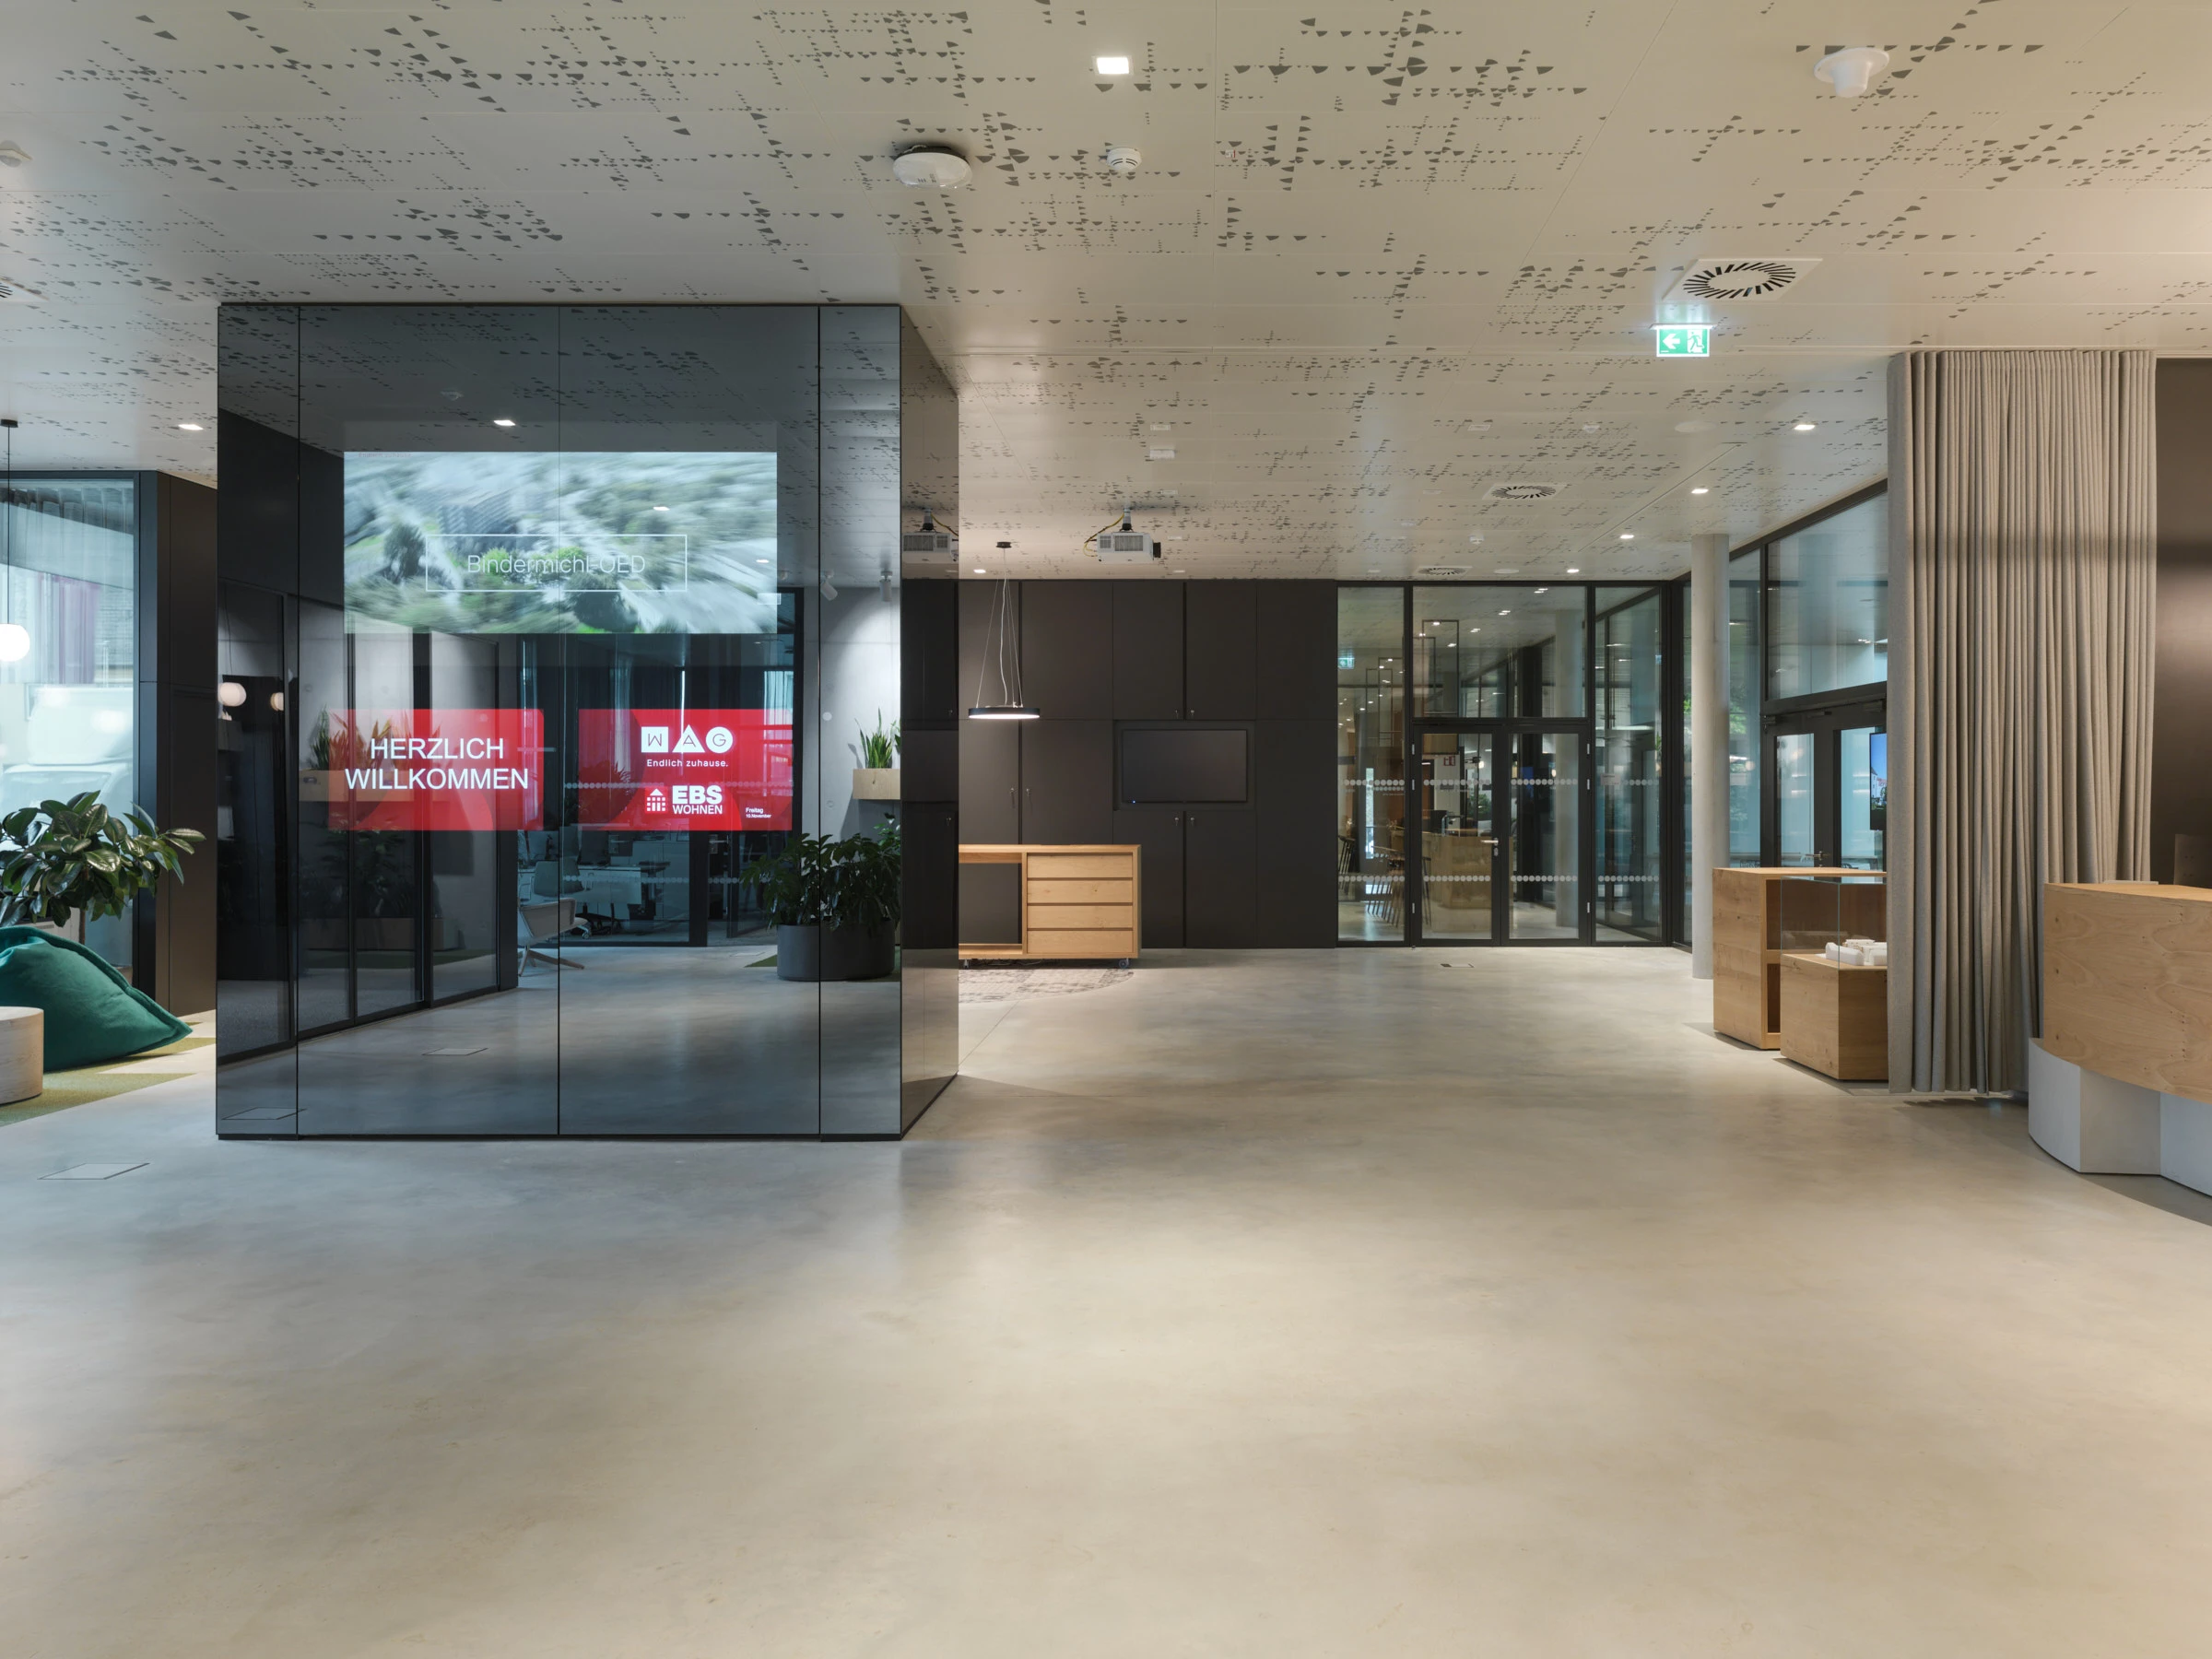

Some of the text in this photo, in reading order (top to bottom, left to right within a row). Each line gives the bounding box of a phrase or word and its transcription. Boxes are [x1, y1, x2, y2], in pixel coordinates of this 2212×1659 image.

[466, 555, 646, 573] Bindermichl-OED
[371, 737, 504, 759] HERZLICH
[646, 759, 729, 768] Endlich zuhause.
[345, 768, 529, 790] WILLKOMMEN
[672, 784, 724, 805] EBS
[672, 805, 724, 815] WOHNEN
[745, 806, 764, 815] Freitag
